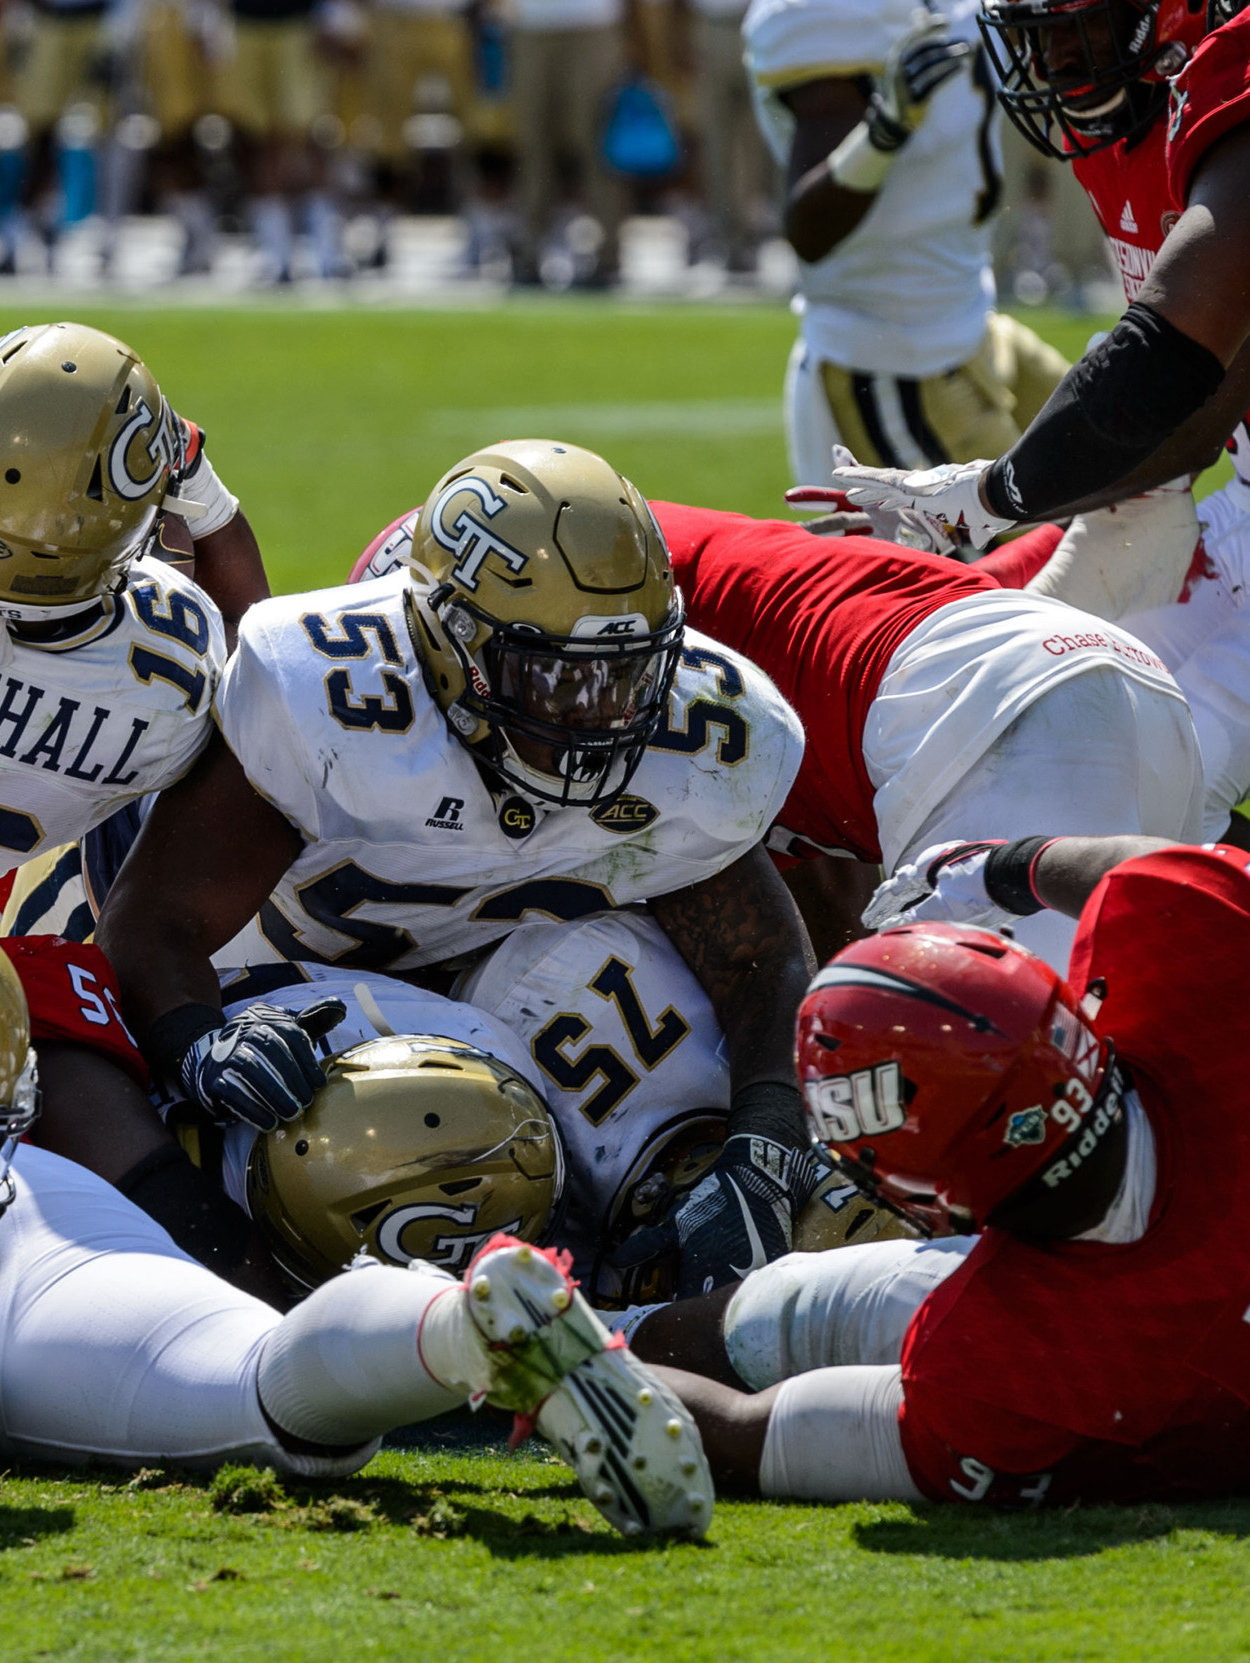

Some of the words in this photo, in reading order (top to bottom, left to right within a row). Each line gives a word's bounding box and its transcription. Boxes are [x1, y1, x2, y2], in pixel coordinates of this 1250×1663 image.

[431, 476, 529, 594] GT
[127, 580, 212, 717] 16
[597, 620, 636, 635] ACC
[1042, 633, 1108, 656] Chase
[298, 612, 416, 736] 53
[425, 818, 465, 832] RUSSELL
[504, 808, 532, 830] GT
[601, 803, 649, 819] ACC
[530, 953, 693, 1128] 75
[804, 1060, 905, 1142] JSU
[1051, 1078, 1094, 1133] 93
